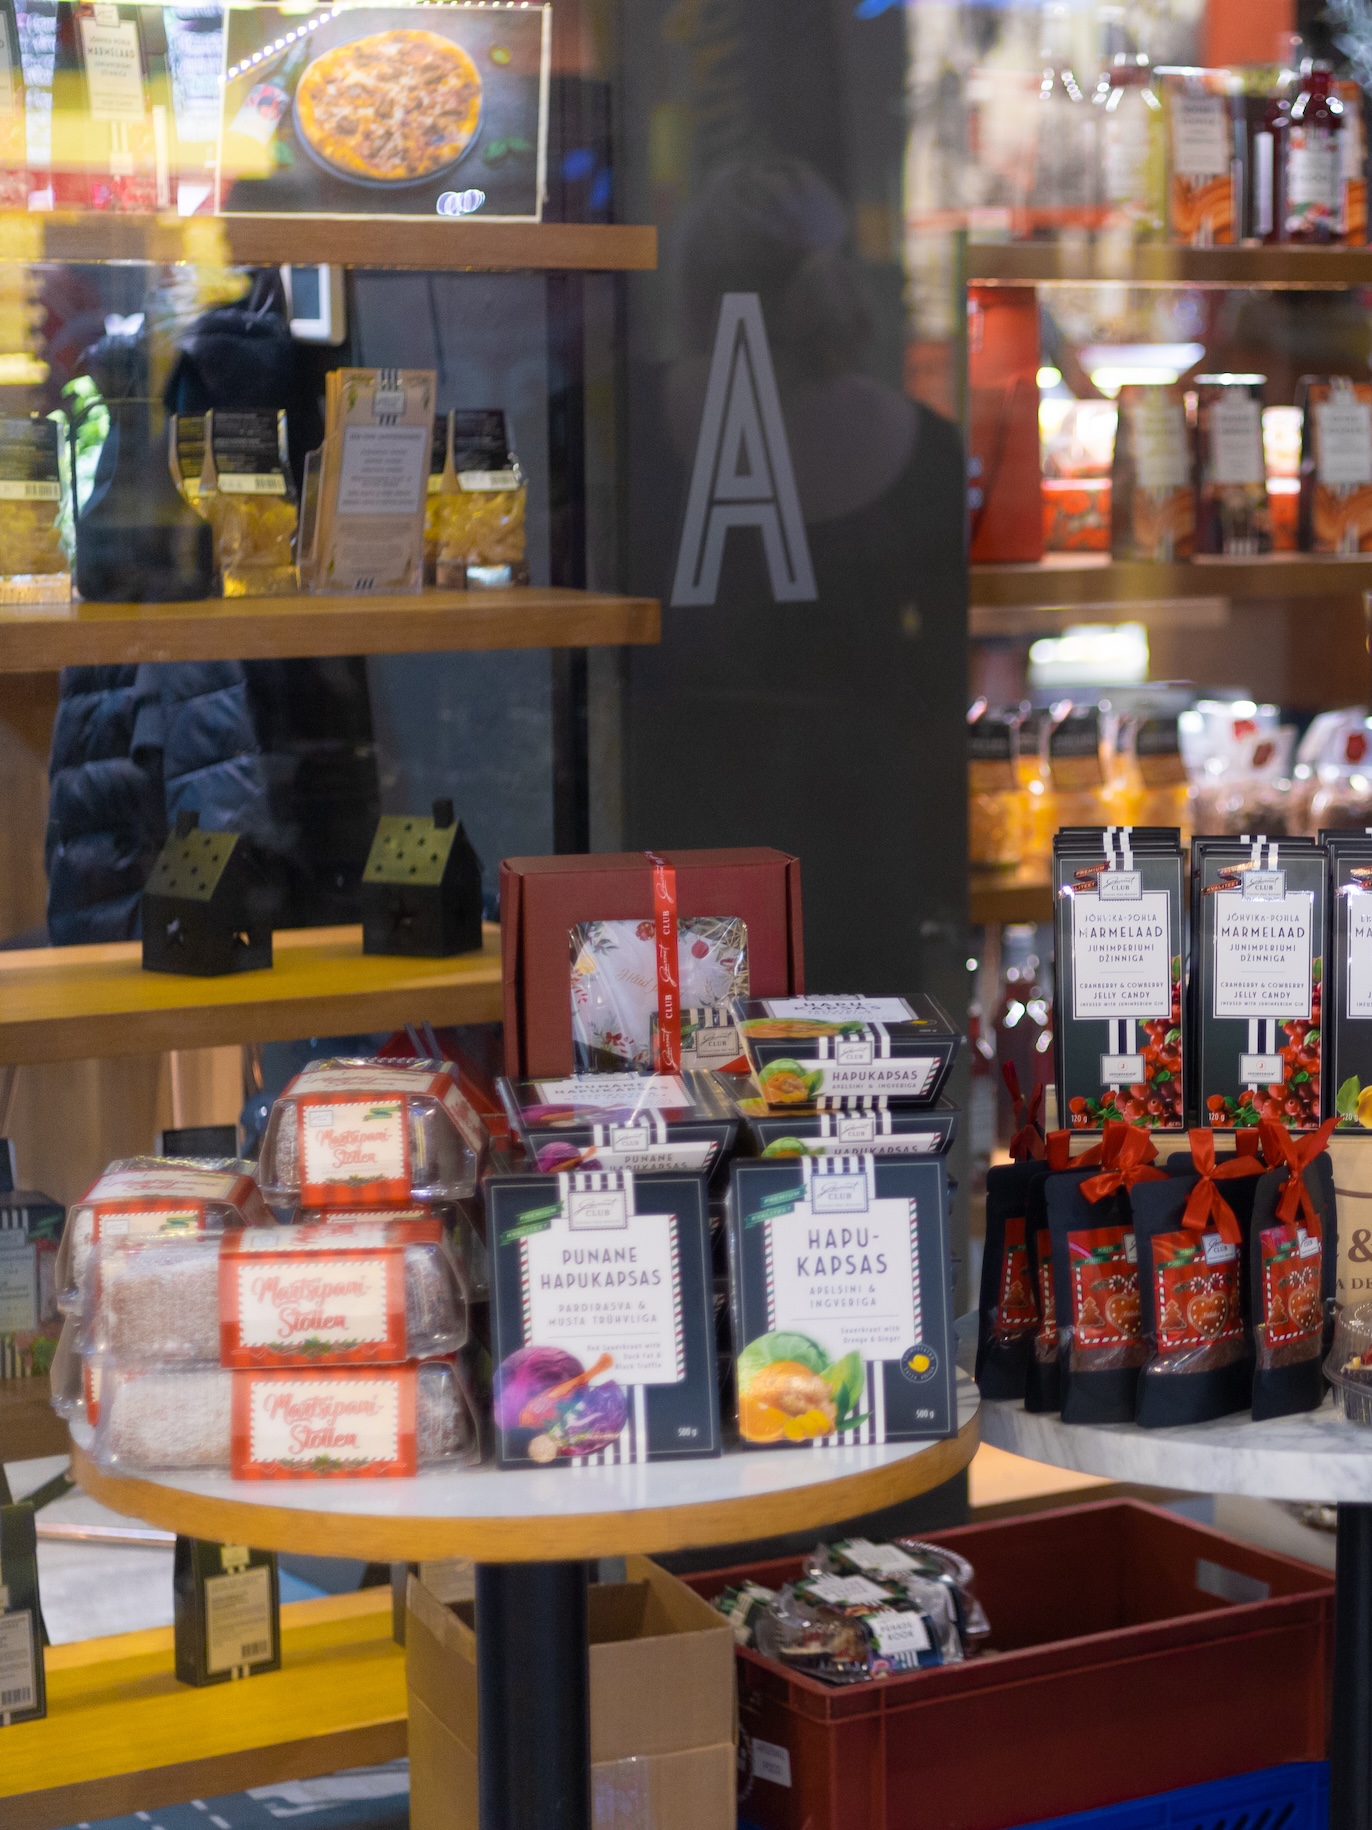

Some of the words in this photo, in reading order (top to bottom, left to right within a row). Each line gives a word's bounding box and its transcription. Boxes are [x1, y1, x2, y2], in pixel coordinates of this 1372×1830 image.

[670, 292, 819, 607] A
[1075, 865, 1105, 876] PREMIUM
[1102, 876, 1136, 889] Gourmet
[662, 910, 671, 935] CLUB
[1079, 926, 1164, 939] MARMELAAD
[1221, 926, 1305, 938] MARMELAAD
[1088, 944, 1155, 952] JUNIMPERIUMI
[1229, 943, 1296, 952] JUNIMPERIUMI
[1098, 954, 1145, 963] DŽINNIGA
[1240, 953, 1286, 963] DŽINNIGA
[1093, 992, 1117, 1000] JELLY
[1121, 991, 1151, 999] CANDY
[1262, 991, 1291, 999] CANDY
[665, 994, 673, 1020] CLUB
[708, 1040, 727, 1048] CLUB
[832, 1070, 918, 1081] HAPUKAPSAS
[878, 1082, 917, 1090] INGVERIGA
[1071, 1114, 1082, 1123] 120
[1083, 1116, 1088, 1124] g
[332, 1147, 379, 1169] Stollen
[624, 1153, 674, 1163] PUNANE
[817, 1181, 859, 1198] Gourmet
[764, 1190, 801, 1204] PREMIUM
[827, 1192, 852, 1200] CLUB
[519, 1206, 557, 1220] PREMIUM
[574, 1198, 618, 1216] Gourmet
[585, 1209, 611, 1217] CLUB
[751, 1206, 792, 1222] KVALITEET
[506, 1223, 549, 1238] KVALITEET
[808, 1227, 880, 1250] HAPU-
[562, 1247, 638, 1265] PUNANE
[797, 1253, 888, 1278] KAPSAS
[541, 1269, 662, 1290] HAPUKAPSAS
[810, 1285, 863, 1295] APELSINI
[868, 1284, 876, 1293] &
[558, 1301, 632, 1313] PARDIRASVA
[638, 1301, 646, 1310] &
[810, 1298, 877, 1309] INGVERIGA
[277, 1306, 349, 1338] Stollen
[549, 1316, 587, 1327] MUSTA
[592, 1314, 658, 1325] TRÜHVLIGA
[840, 1326, 882, 1334] Sauerkraut
[884, 1324, 900, 1332] with
[842, 1336, 868, 1344] Orange
[877, 1334, 900, 1344] Ginger
[602, 1342, 643, 1351] Sauerkraut
[916, 1409, 928, 1418] 500
[930, 1410, 935, 1419] g
[288, 1424, 361, 1456] Stollen
